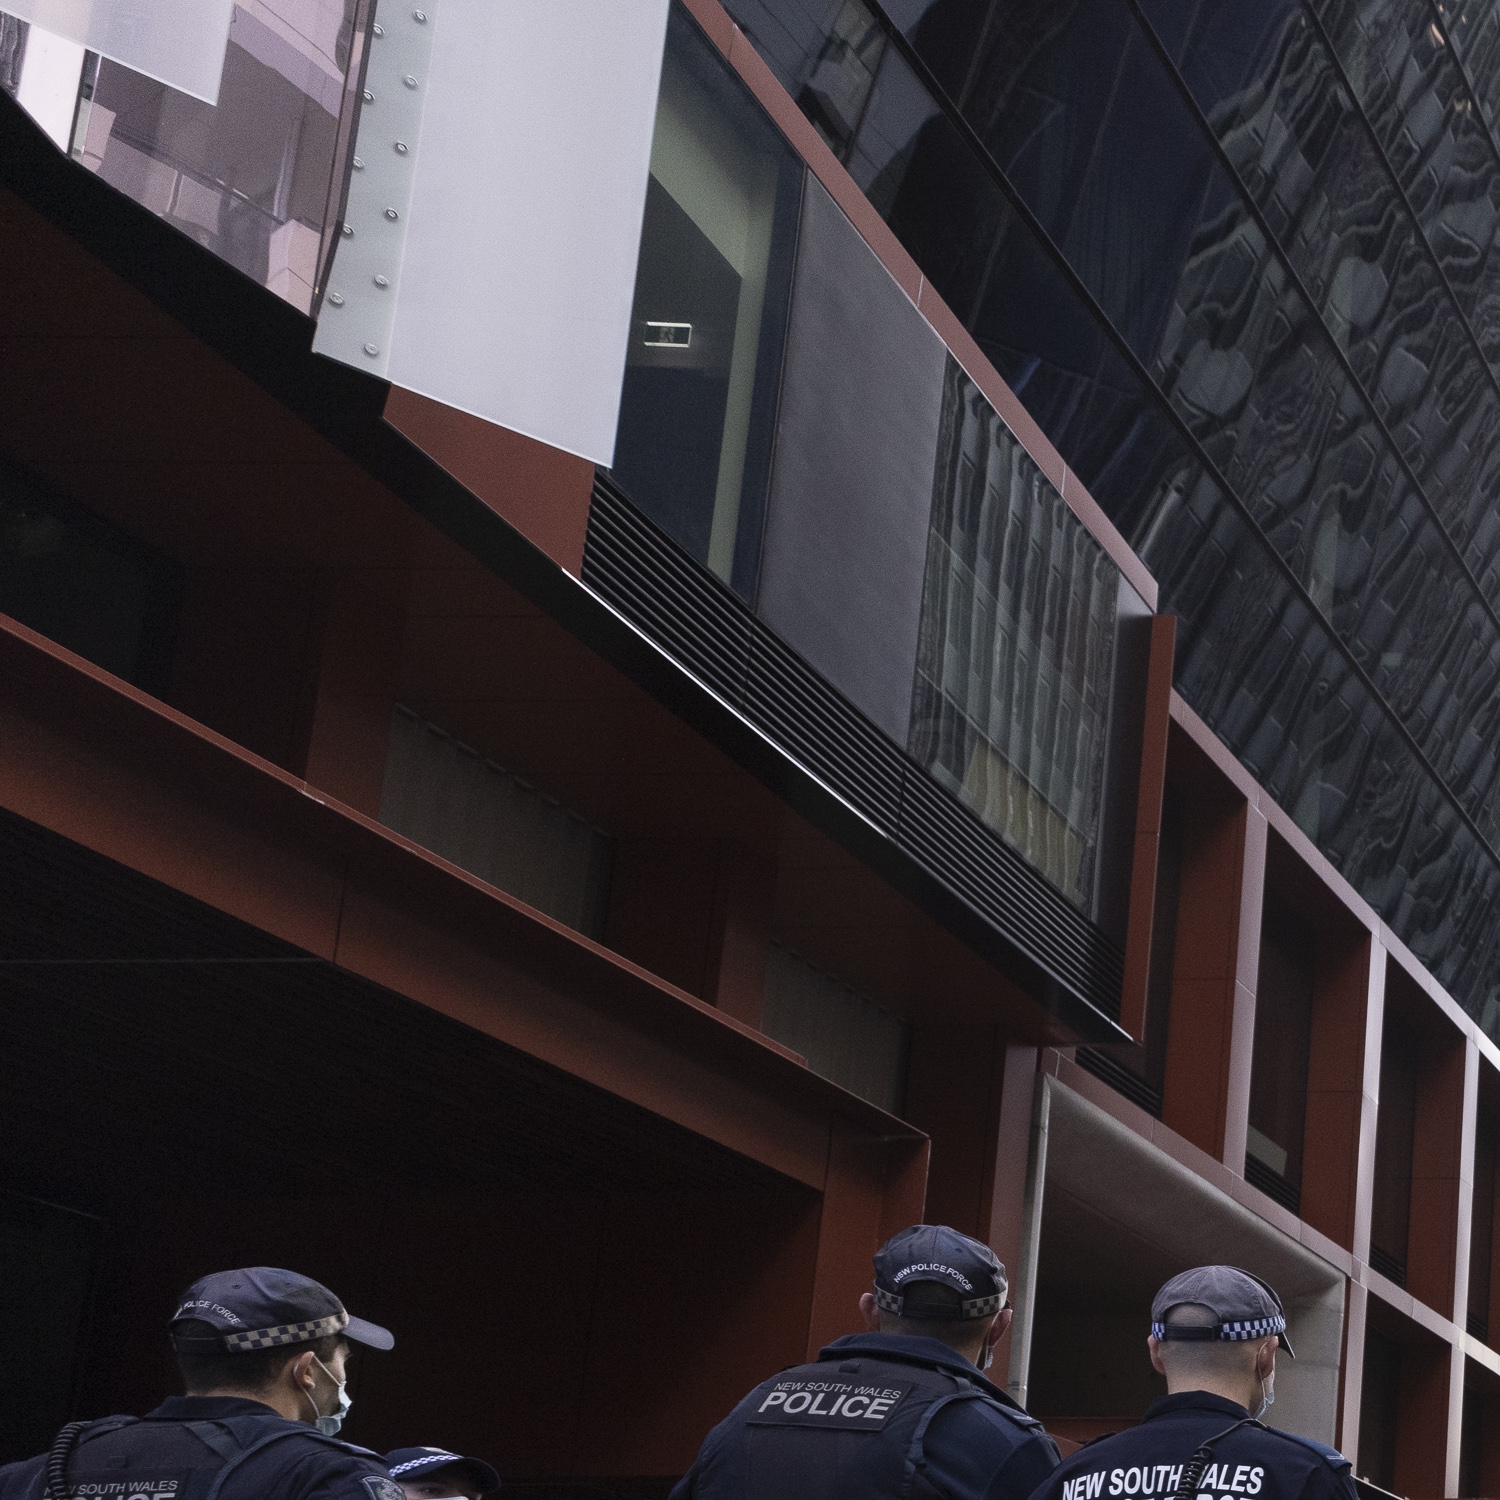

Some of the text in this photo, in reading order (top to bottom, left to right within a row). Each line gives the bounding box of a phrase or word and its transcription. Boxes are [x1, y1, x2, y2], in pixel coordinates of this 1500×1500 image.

[893, 1263, 973, 1290] NSW POLICE FORCE
[211, 1303, 241, 1325] FORCE
[774, 1382, 901, 1399] NEW SOUTH WALES
[758, 1391, 896, 1420] POLICE
[78, 1483, 126, 1495] SOUTH
[129, 1480, 178, 1492] WALES
[1108, 1465, 1184, 1496] SOUTH
[1195, 1463, 1264, 1495] ALES
